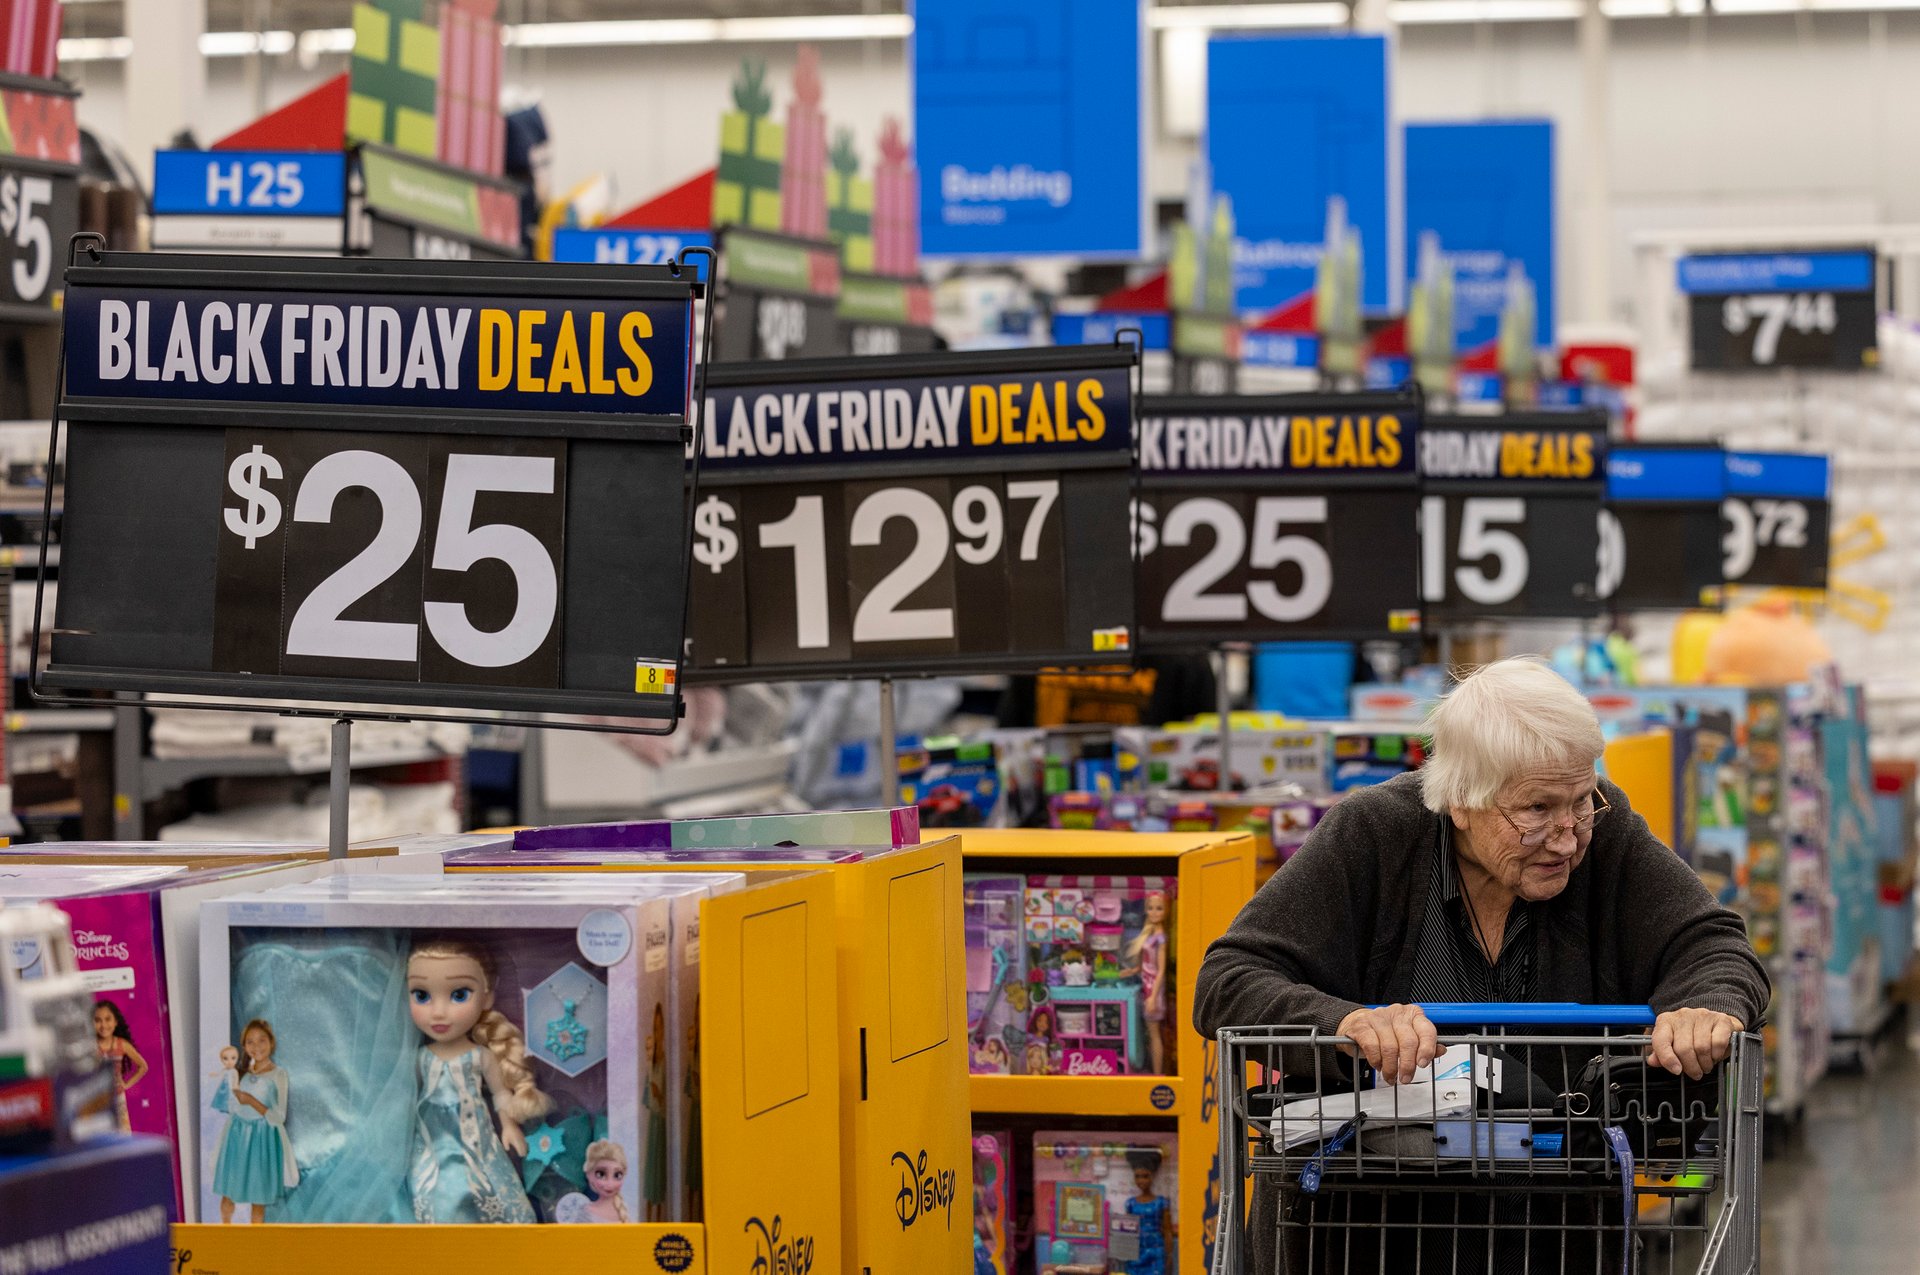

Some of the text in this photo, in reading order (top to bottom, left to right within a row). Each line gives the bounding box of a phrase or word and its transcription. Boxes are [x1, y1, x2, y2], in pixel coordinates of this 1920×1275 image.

[942, 164, 1071, 207] Bedding
[99, 299, 273, 384] BLACK
[281, 304, 473, 390] FRIDAY
[478, 308, 654, 396] DEALS
[815, 384, 966, 453] FRIDAY
[969, 378, 1105, 446] DEALS
[1166, 416, 1290, 469] FRIDAY
[1290, 413, 1402, 469] DEALS
[1500, 432, 1595, 479] DEALS
[223, 445, 558, 668] $25
[648, 667, 656, 683] 8
[73, 929, 113, 948] Disney
[1067, 1052, 1113, 1075] Barbie
